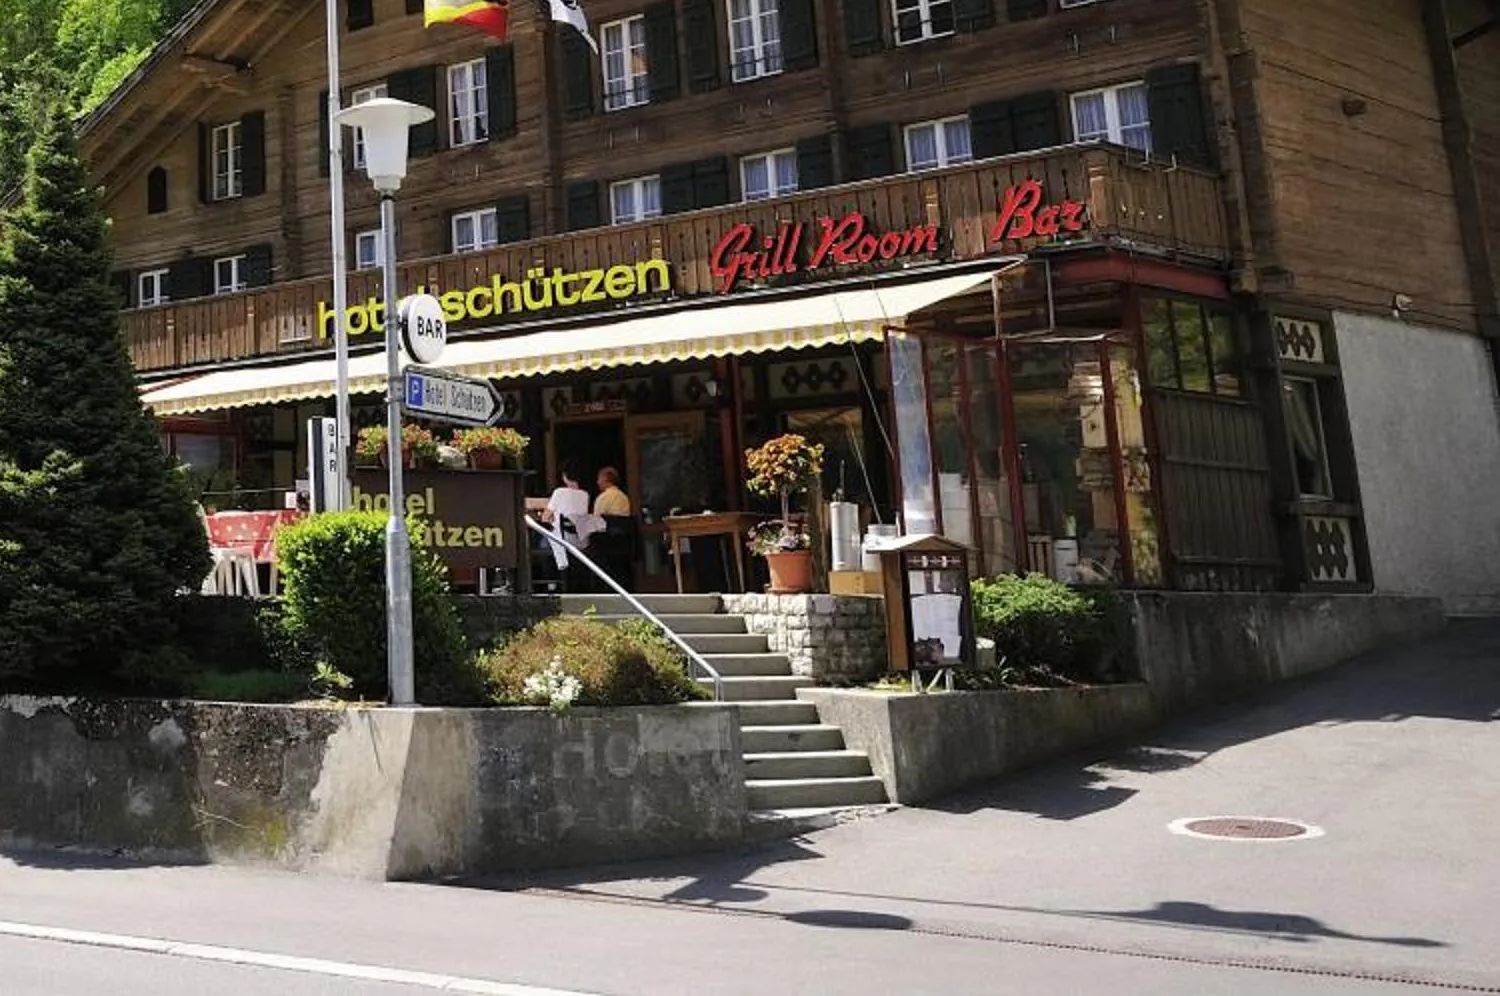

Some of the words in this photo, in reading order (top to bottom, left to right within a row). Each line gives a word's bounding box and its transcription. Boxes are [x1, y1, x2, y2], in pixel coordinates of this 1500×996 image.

[710, 219, 802, 294] Grill
[809, 211, 938, 270] Room
[991, 177, 1085, 242] Bar
[317, 284, 429, 339] hot
[439, 259, 671, 323] schützen
[417, 316, 443, 340] BAR
[352, 484, 437, 515] hoel
